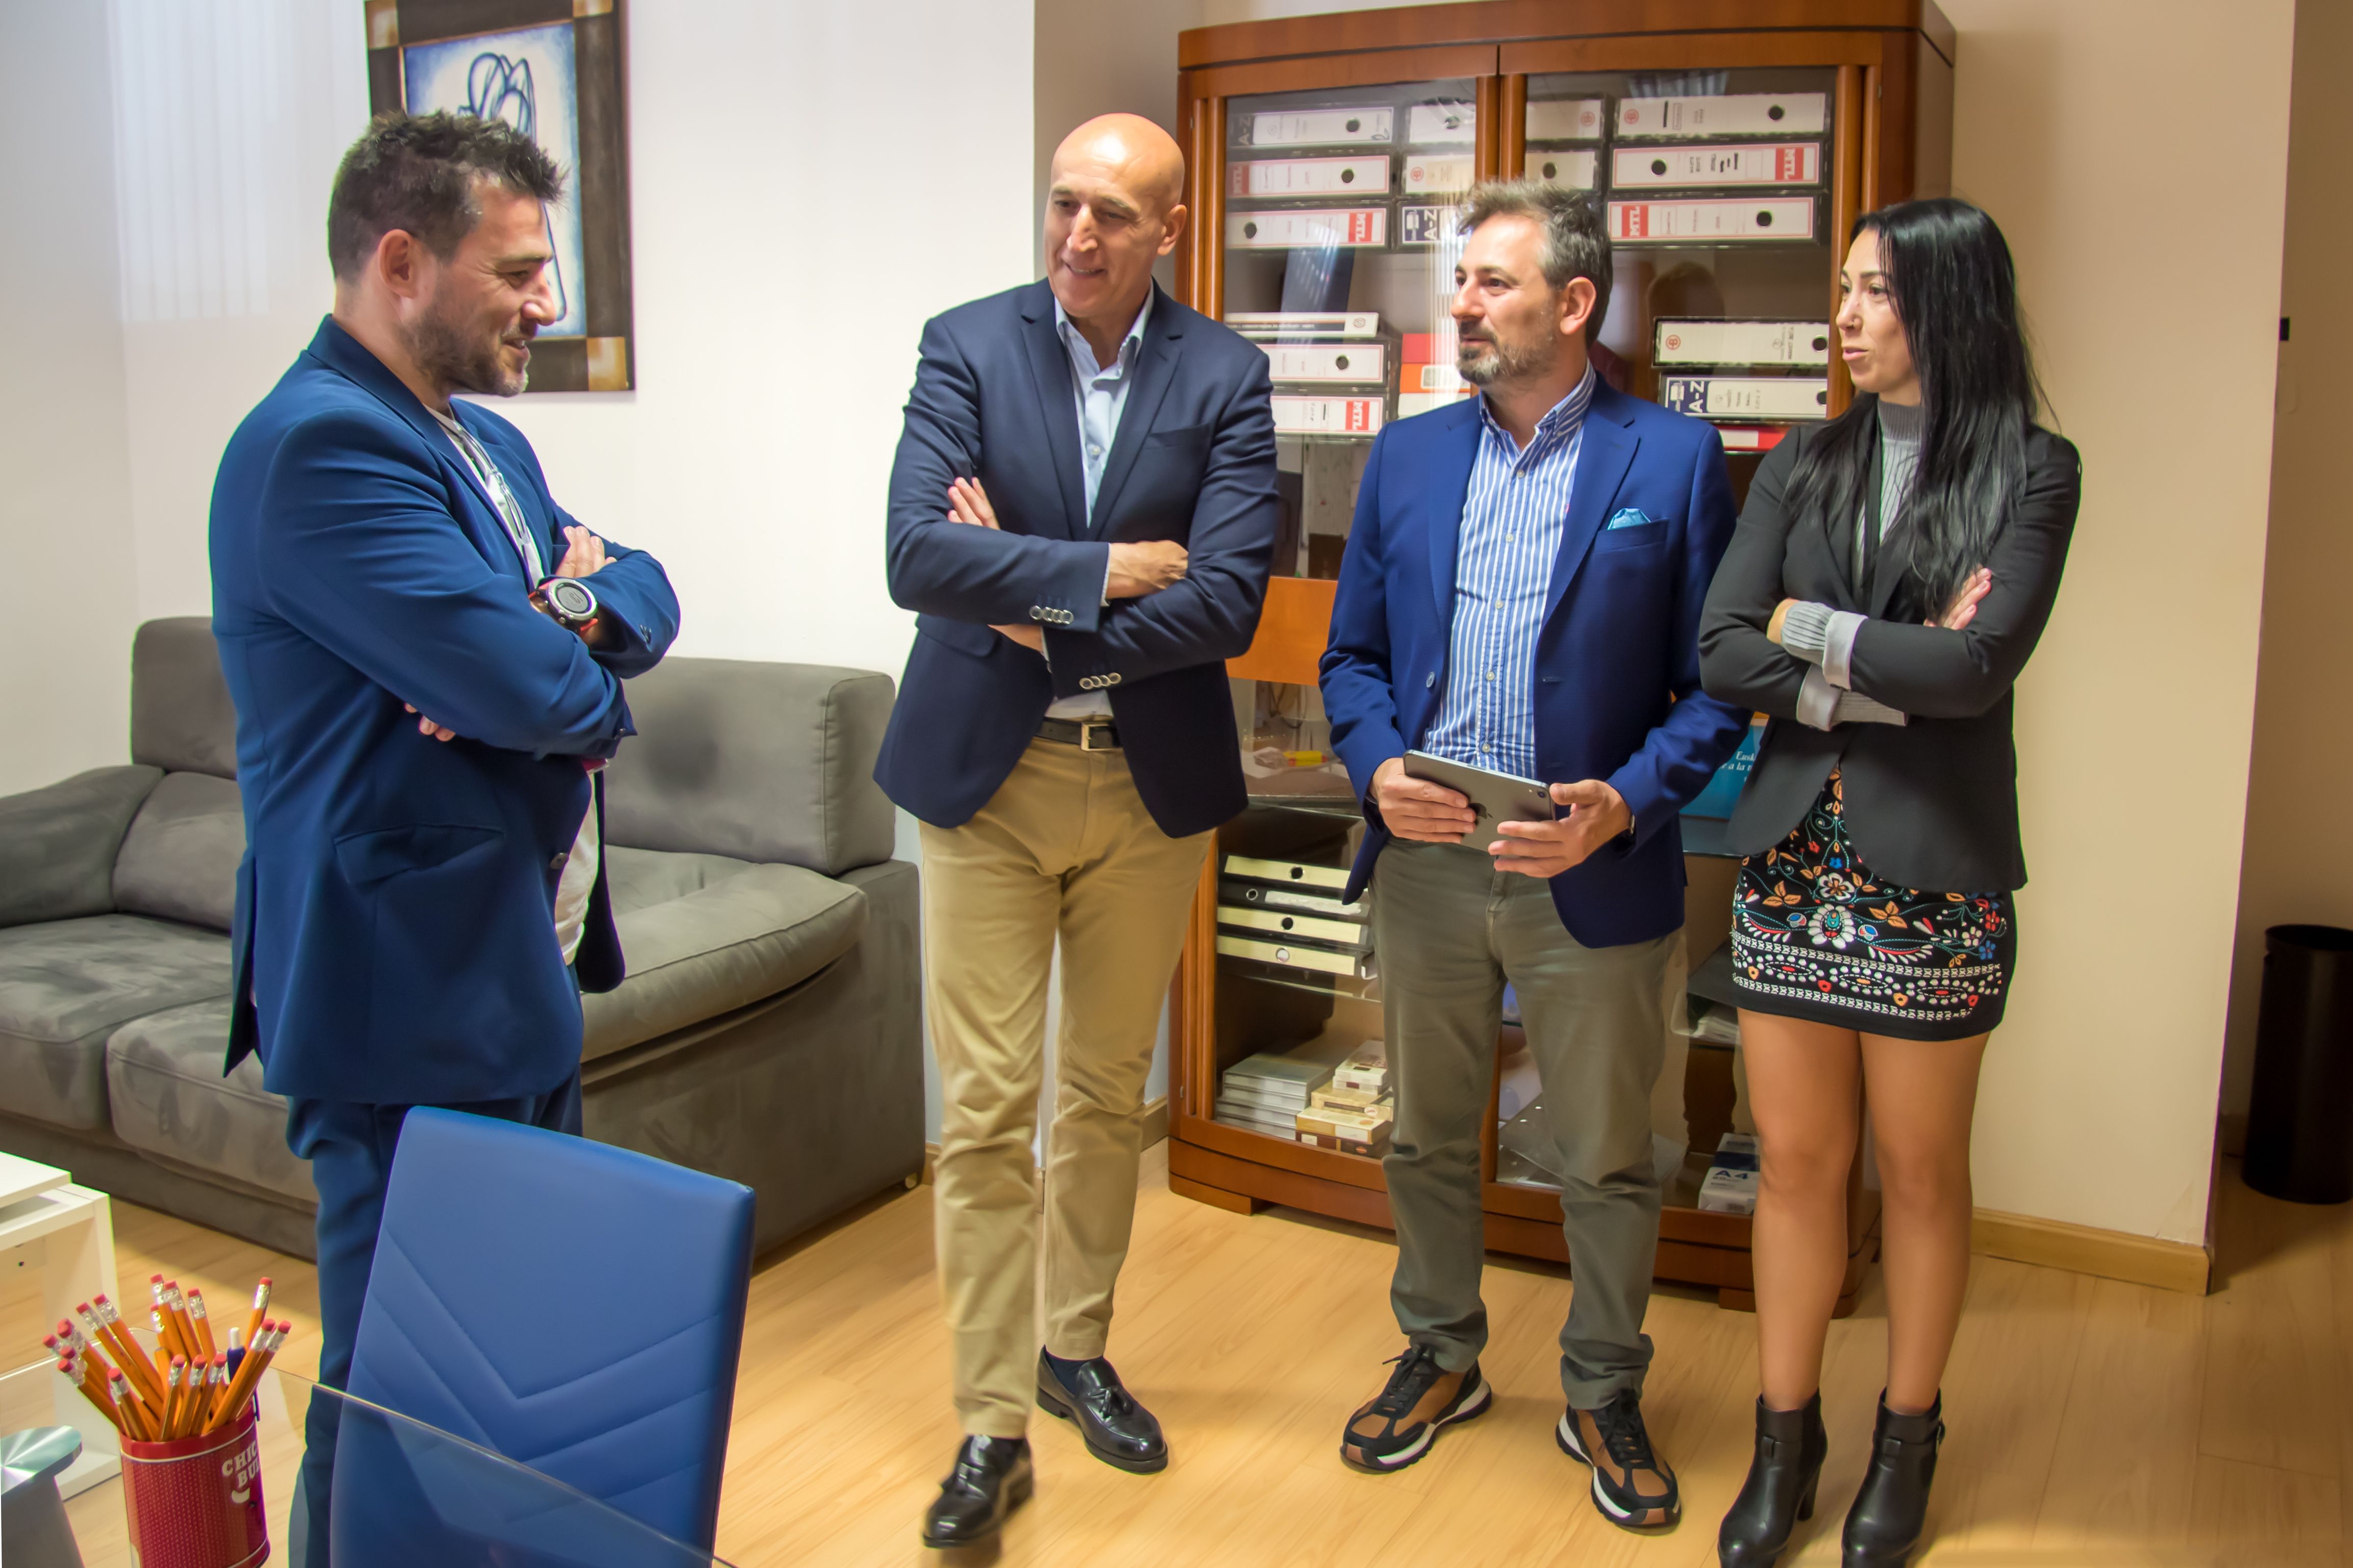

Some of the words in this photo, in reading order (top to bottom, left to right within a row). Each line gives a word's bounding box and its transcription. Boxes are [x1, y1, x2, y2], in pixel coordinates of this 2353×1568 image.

[1784, 148, 1795, 180] MTL
[1356, 213, 1366, 242] MTL
[1424, 209, 1438, 240] A-Z
[1630, 206, 1640, 237] MTL
[1689, 381, 1705, 413] A-Z
[1353, 401, 1363, 429] MTL
